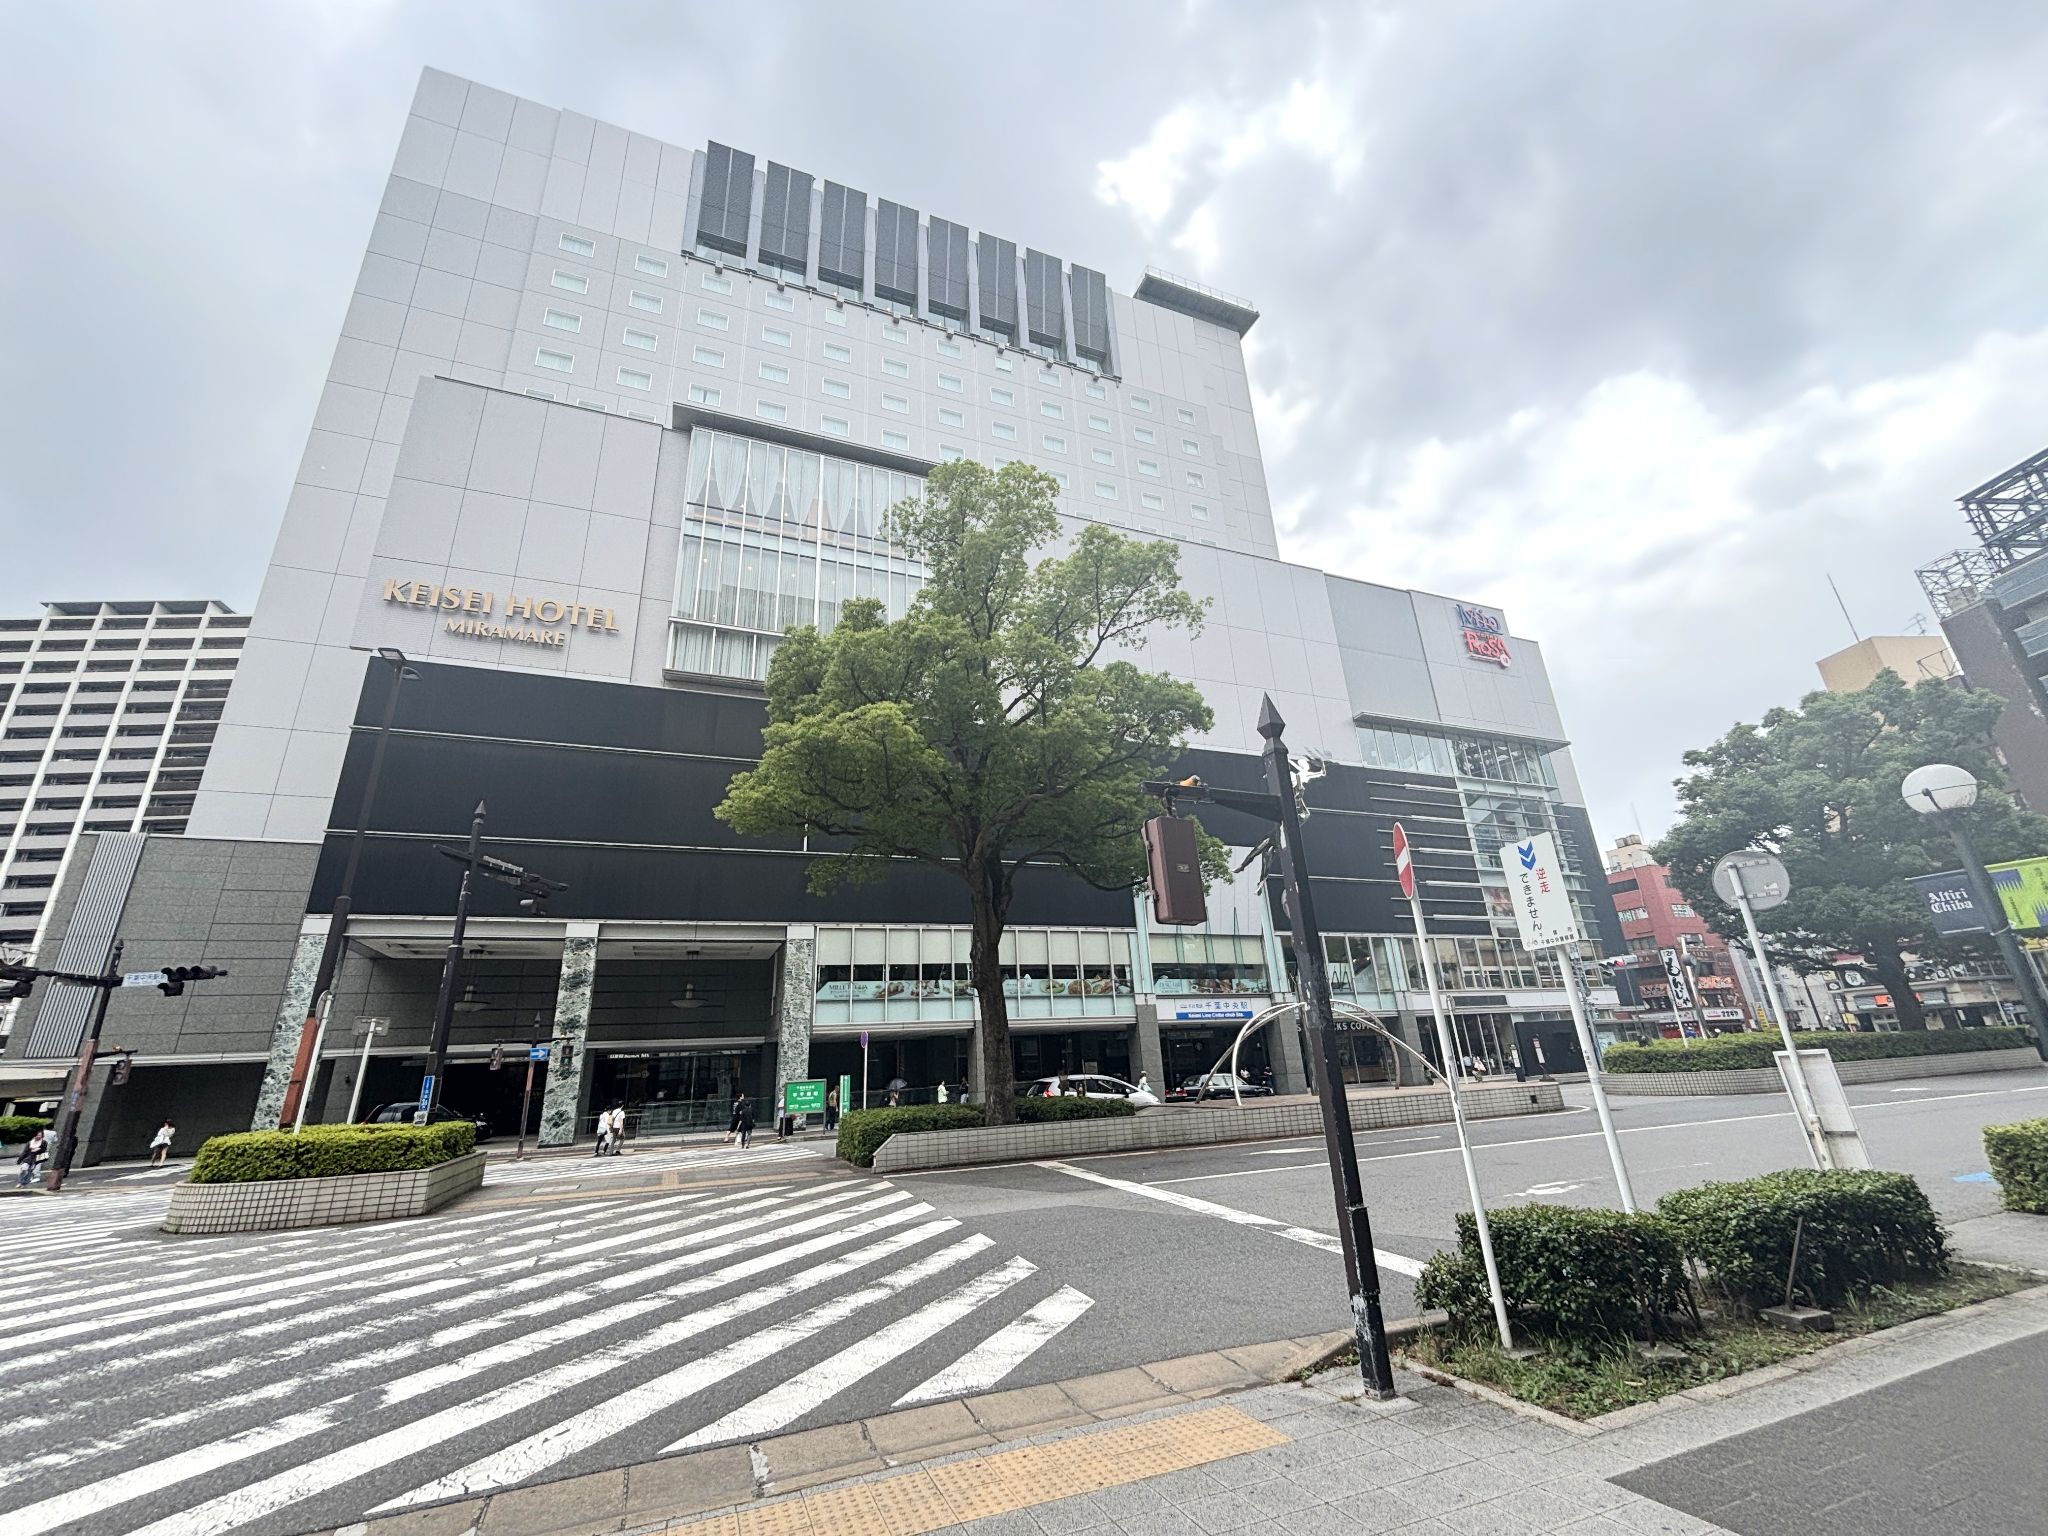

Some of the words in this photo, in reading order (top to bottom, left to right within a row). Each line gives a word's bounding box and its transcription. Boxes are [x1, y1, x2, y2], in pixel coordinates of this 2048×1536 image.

[383, 578, 494, 615] KEISEI
[505, 594, 619, 632] HOTEL
[444, 617, 566, 647] MIRAMARE
[1535, 867, 1551, 894] 逆走
[1519, 872, 1543, 932] できません
[1930, 899, 1974, 914] Chiba
[1205, 1001, 1249, 1010] 千葉中央駅
